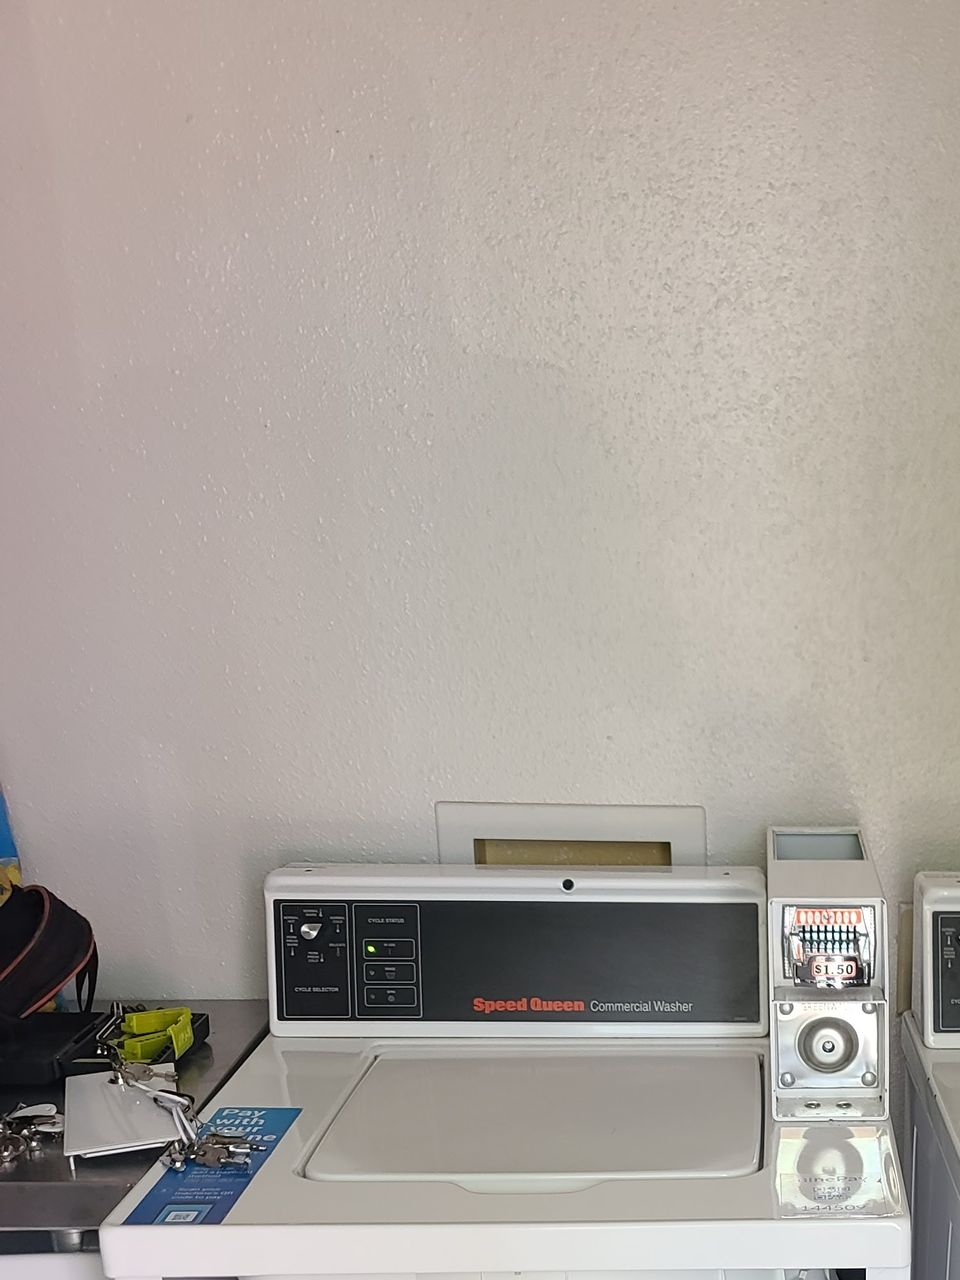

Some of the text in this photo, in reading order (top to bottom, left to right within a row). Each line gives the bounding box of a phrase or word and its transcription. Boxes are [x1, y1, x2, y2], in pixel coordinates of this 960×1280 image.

[815, 965, 853, 974] $1.50
[473, 998, 693, 1014] Speed Queen Commercial Washer
[222, 1109, 266, 1118] Pay
